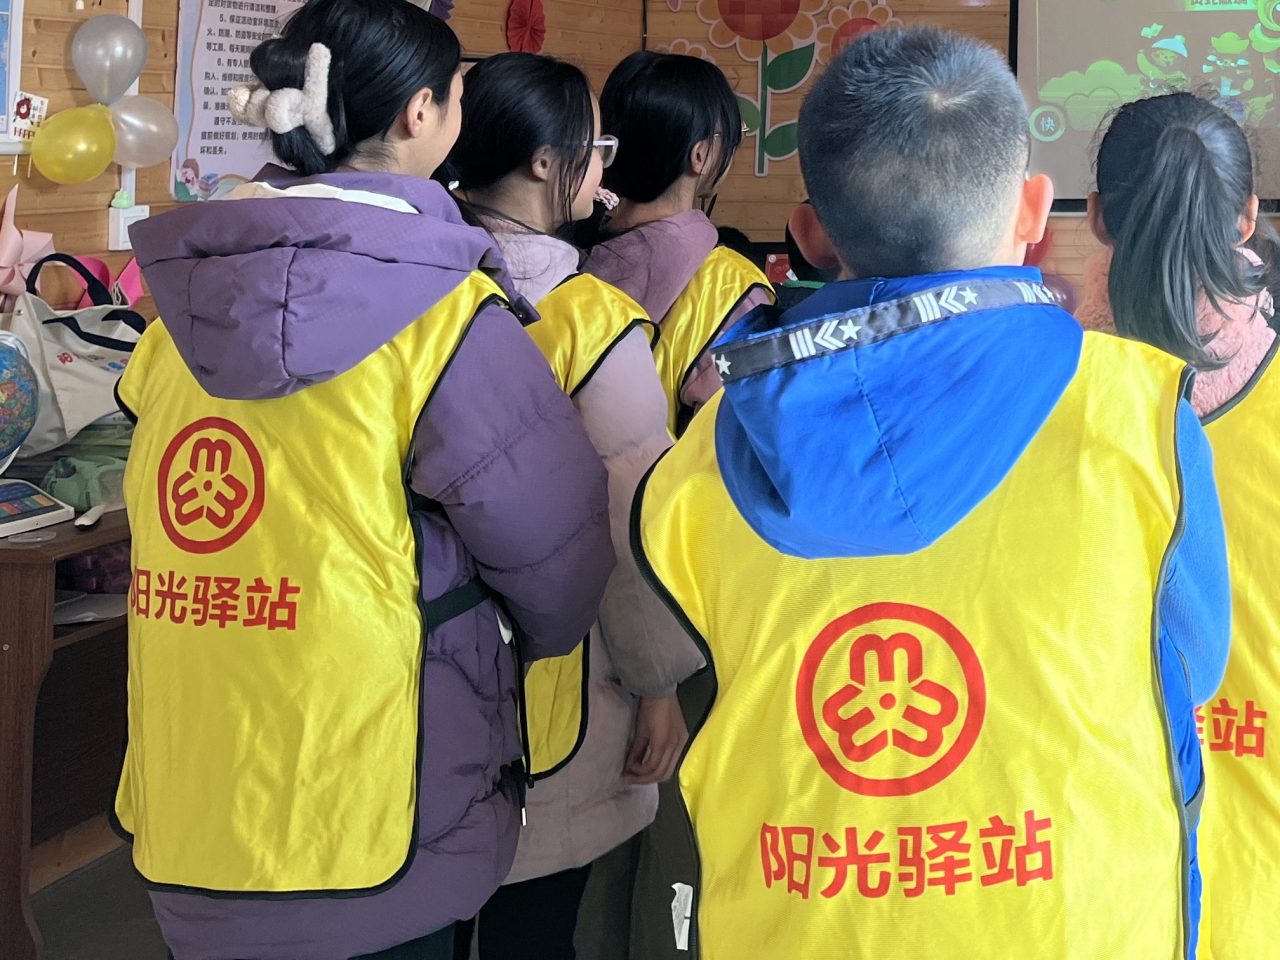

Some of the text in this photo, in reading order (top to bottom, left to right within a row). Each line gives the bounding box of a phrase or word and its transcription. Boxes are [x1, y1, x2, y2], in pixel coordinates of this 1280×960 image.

[131, 568, 301, 631] 阳光驿站
[760, 809, 1054, 900] 阳光驿站
